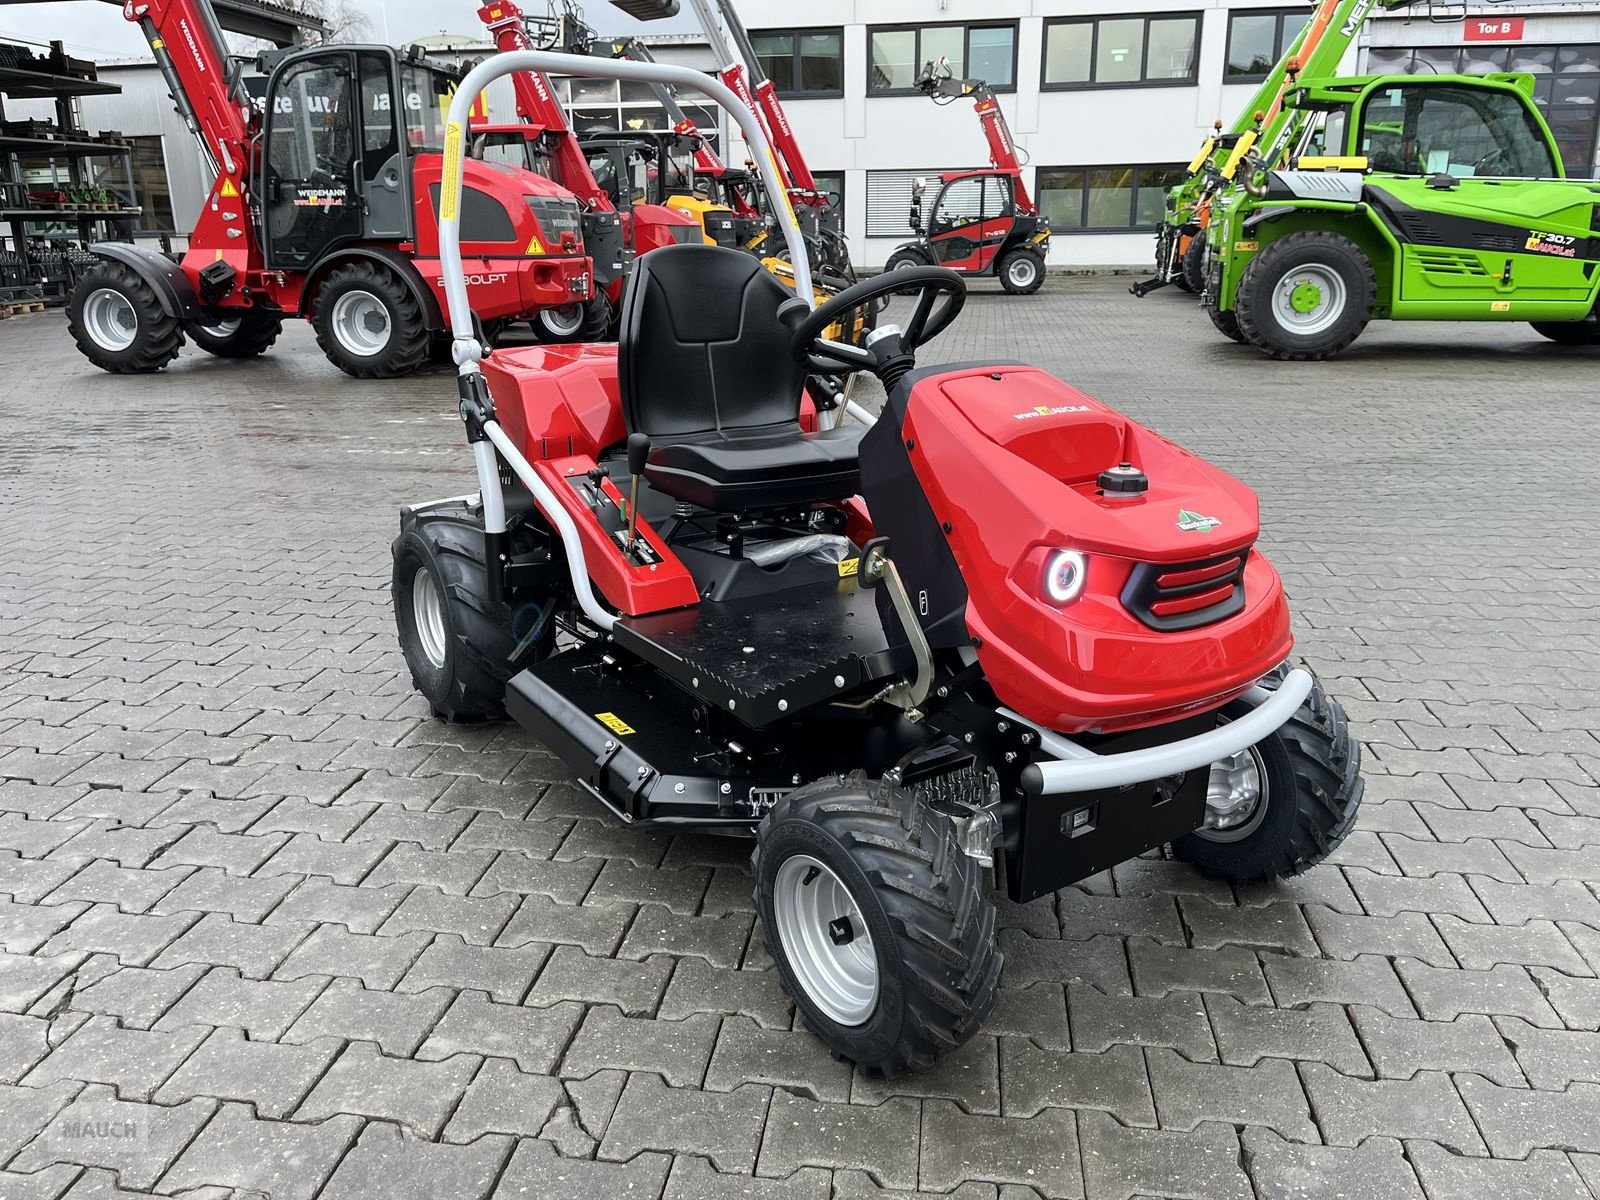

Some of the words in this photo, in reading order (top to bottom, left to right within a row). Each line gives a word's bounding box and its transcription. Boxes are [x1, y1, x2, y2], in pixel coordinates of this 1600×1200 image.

[1477, 22, 1499, 34] Tor
[1500, 22, 1511, 33] B
[180, 18, 206, 72] WEIDEMANN
[768, 92, 790, 137] WEIDEMANN
[298, 189, 346, 198] WEIDEMANN
